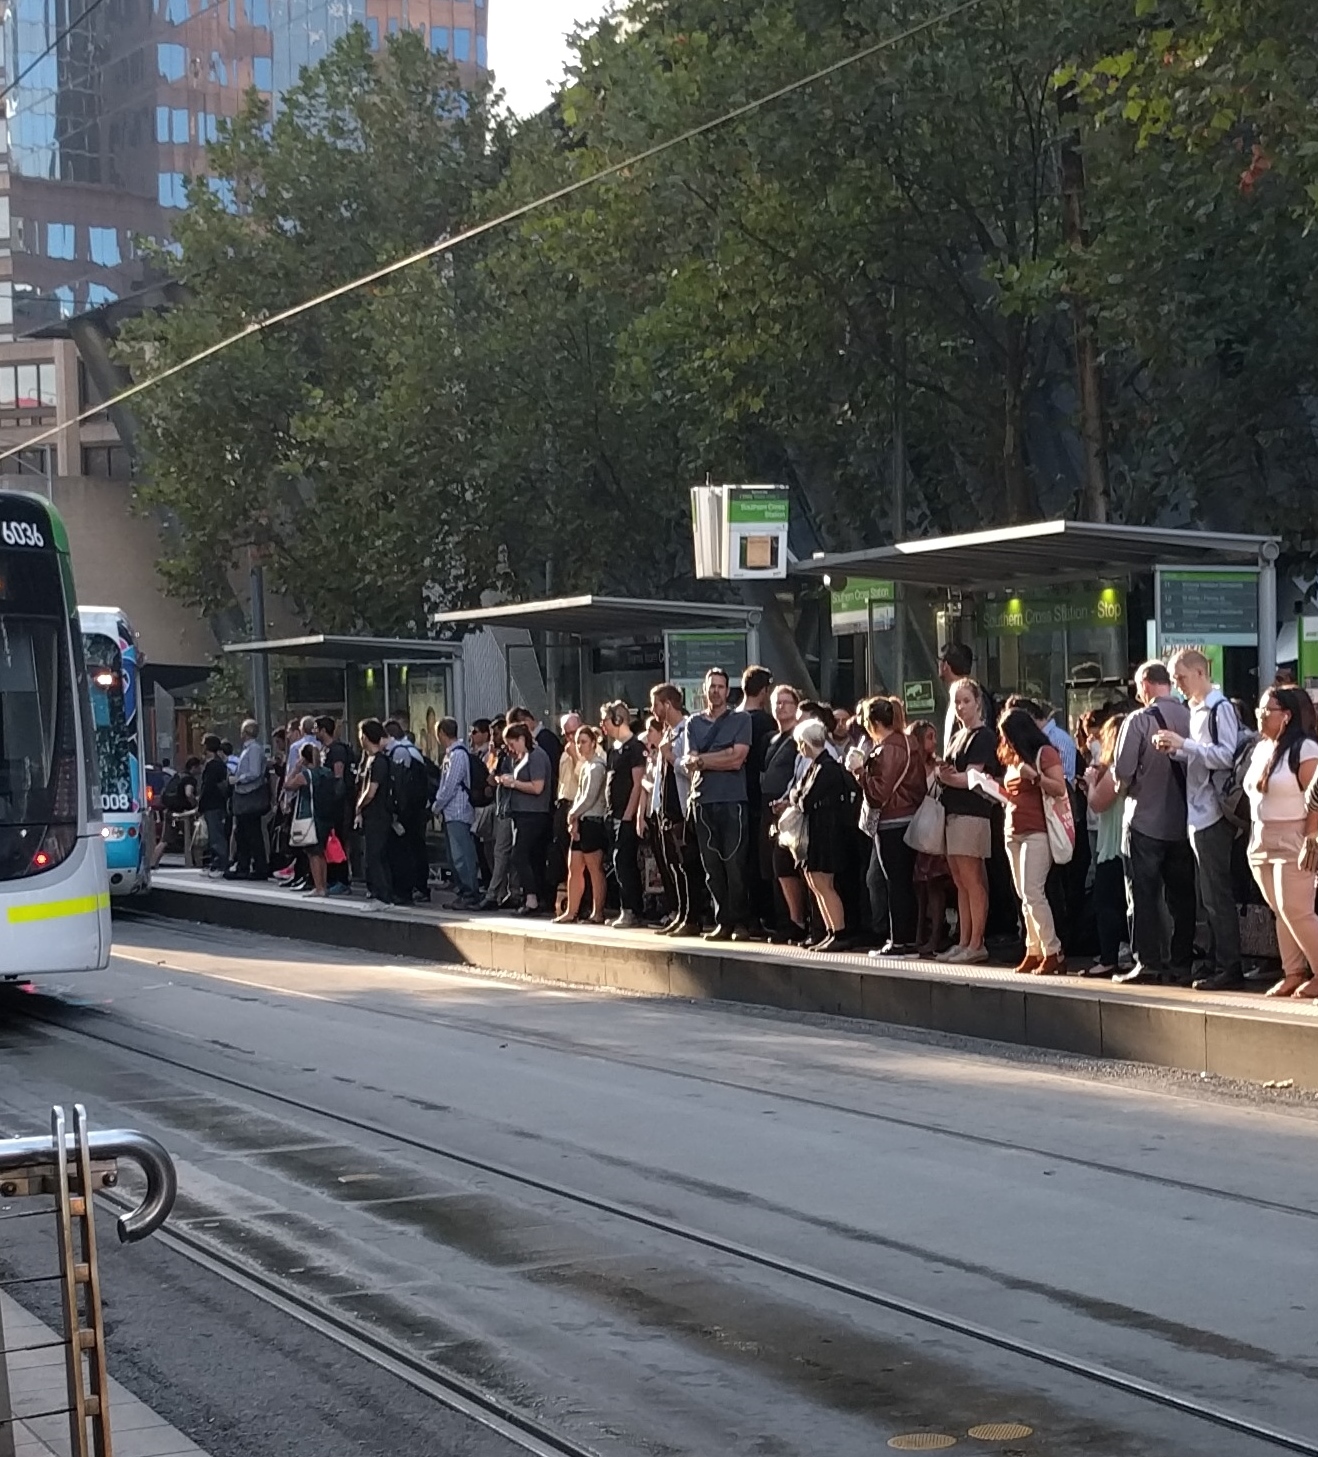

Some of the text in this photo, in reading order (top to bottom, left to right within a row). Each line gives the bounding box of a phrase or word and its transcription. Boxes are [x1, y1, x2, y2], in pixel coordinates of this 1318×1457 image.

[2, 521, 44, 548] 6036
[983, 612, 1023, 629] Southern
[1025, 608, 1052, 625] Cross
[1054, 605, 1088, 622] Station
[1097, 600, 1121, 621] Stop
